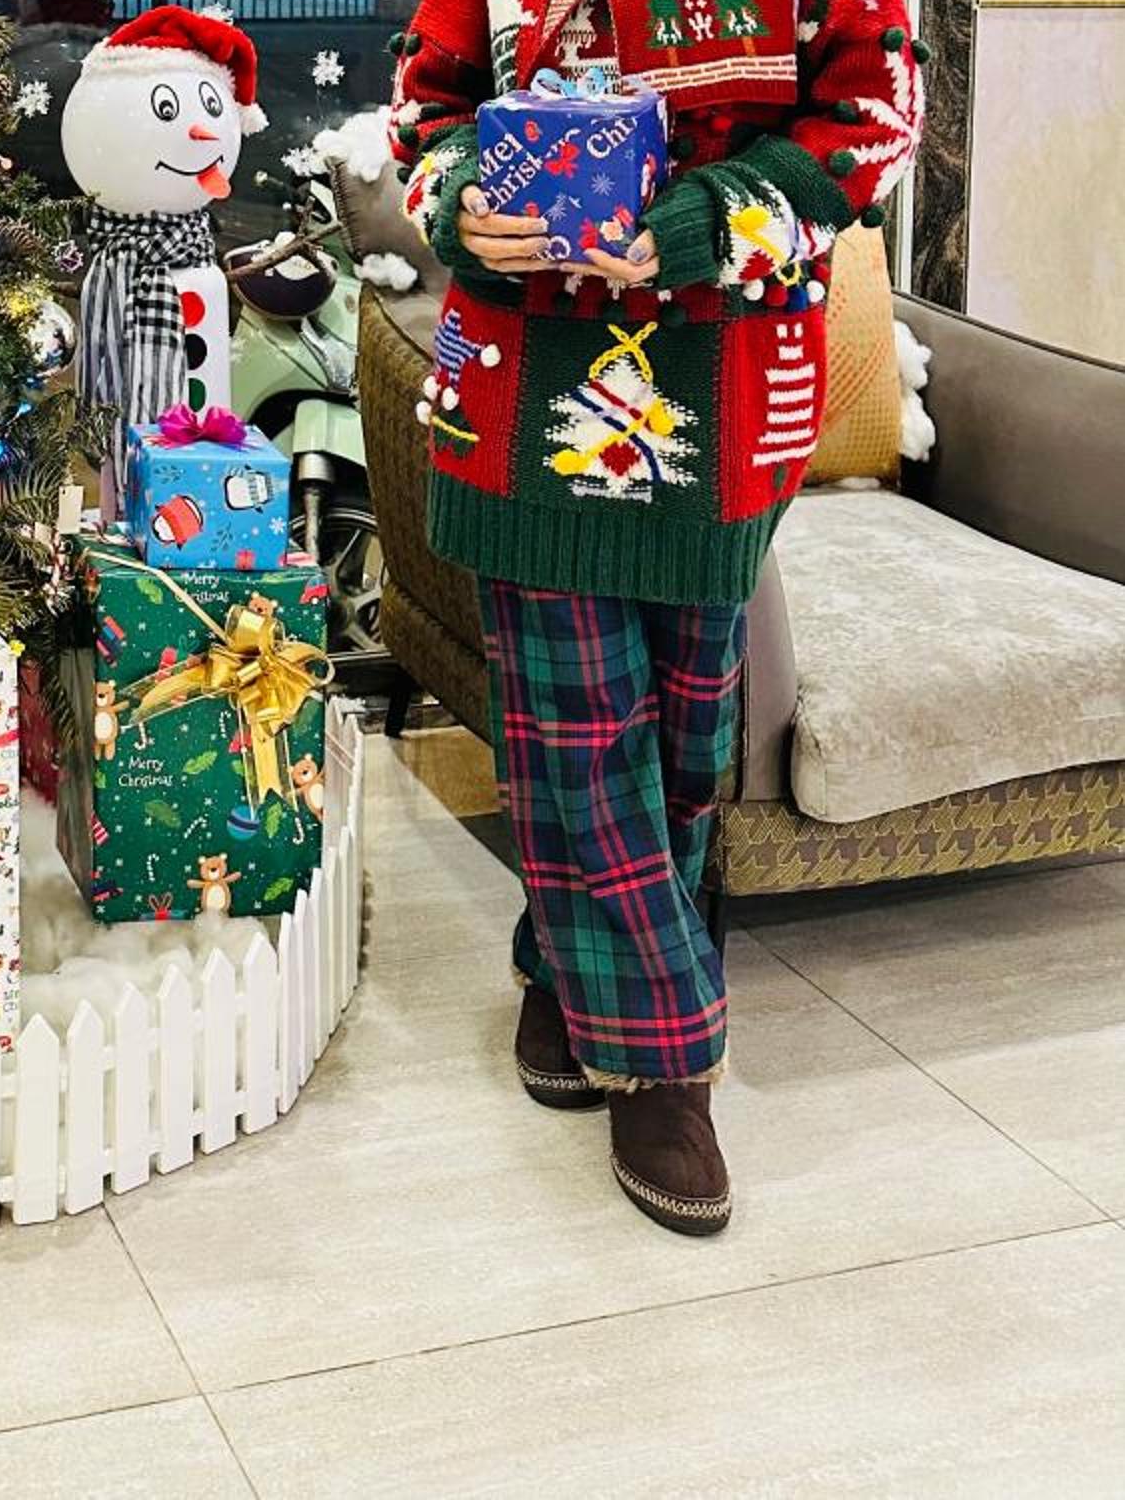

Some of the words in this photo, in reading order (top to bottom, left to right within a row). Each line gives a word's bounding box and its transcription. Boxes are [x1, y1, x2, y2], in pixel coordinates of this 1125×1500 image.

[181, 573, 220, 589] Merry
[128, 756, 165, 773] Merry
[118, 773, 174, 788] Christmas
